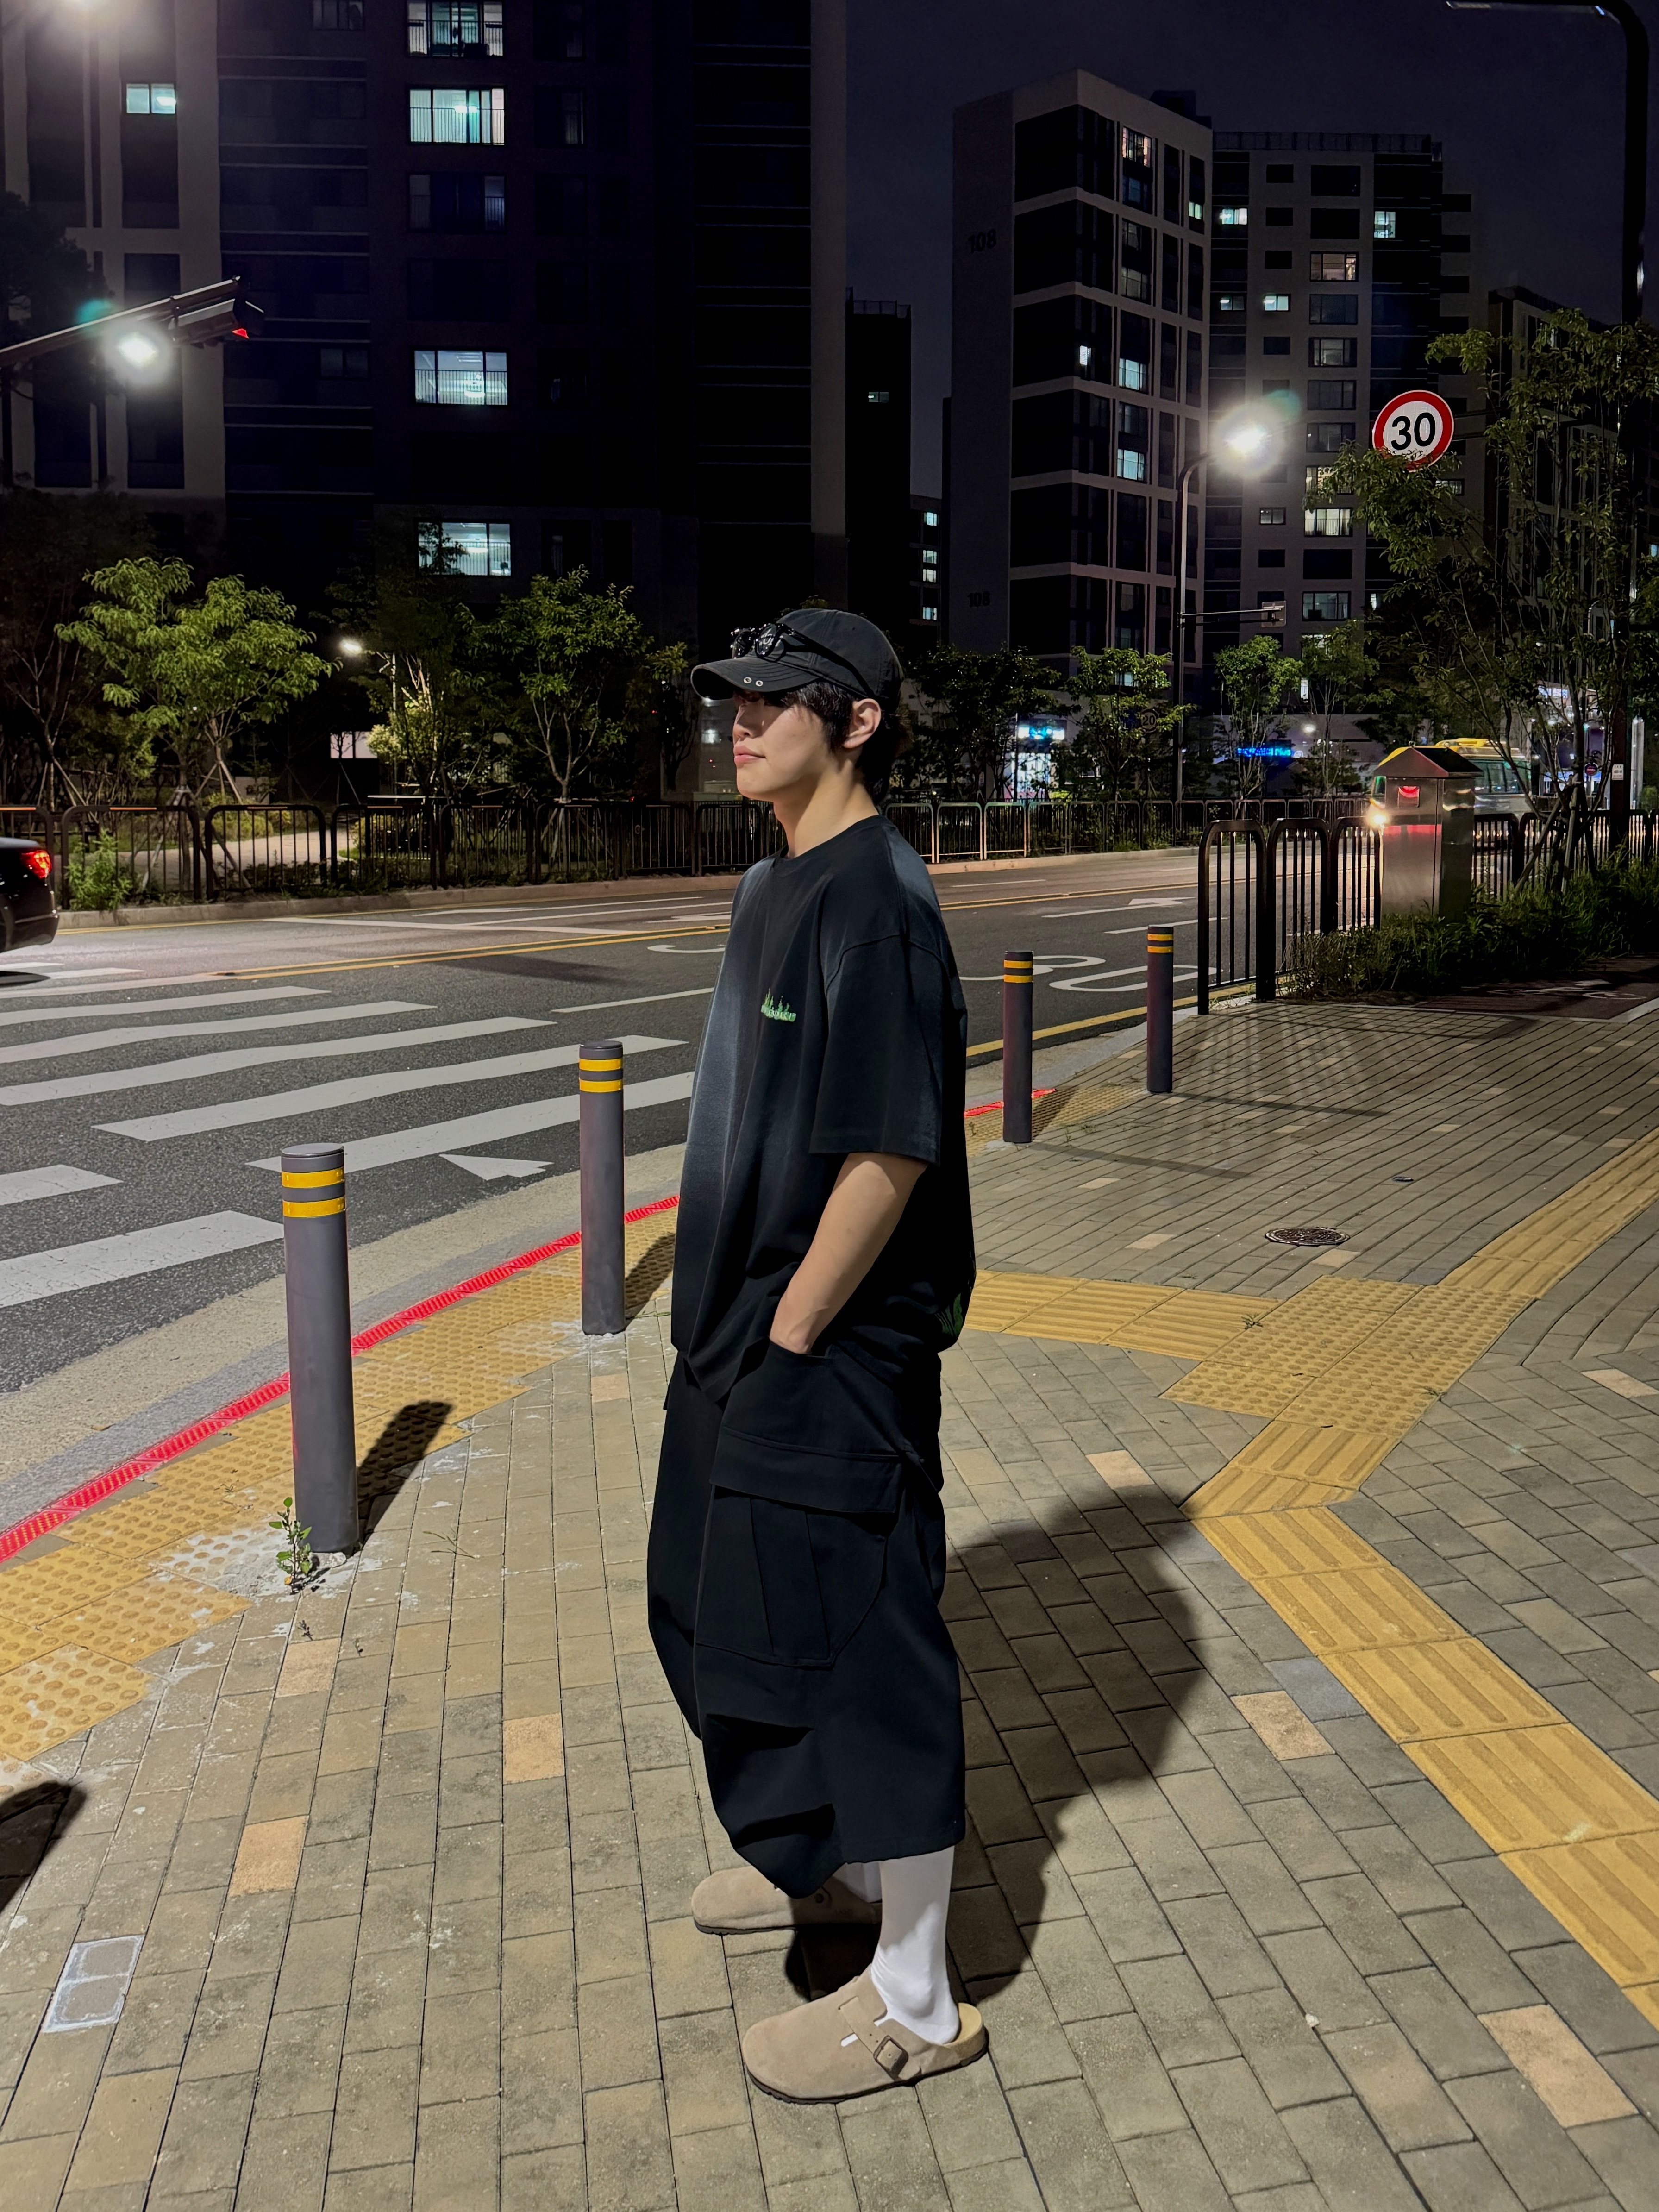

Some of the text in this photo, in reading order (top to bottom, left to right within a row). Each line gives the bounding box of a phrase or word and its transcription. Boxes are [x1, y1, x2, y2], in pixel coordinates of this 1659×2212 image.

[968, 229, 997, 254] 108
[1391, 412, 1436, 450] 30
[967, 591, 990, 608] 108
[1142, 715, 1155, 725] 20
